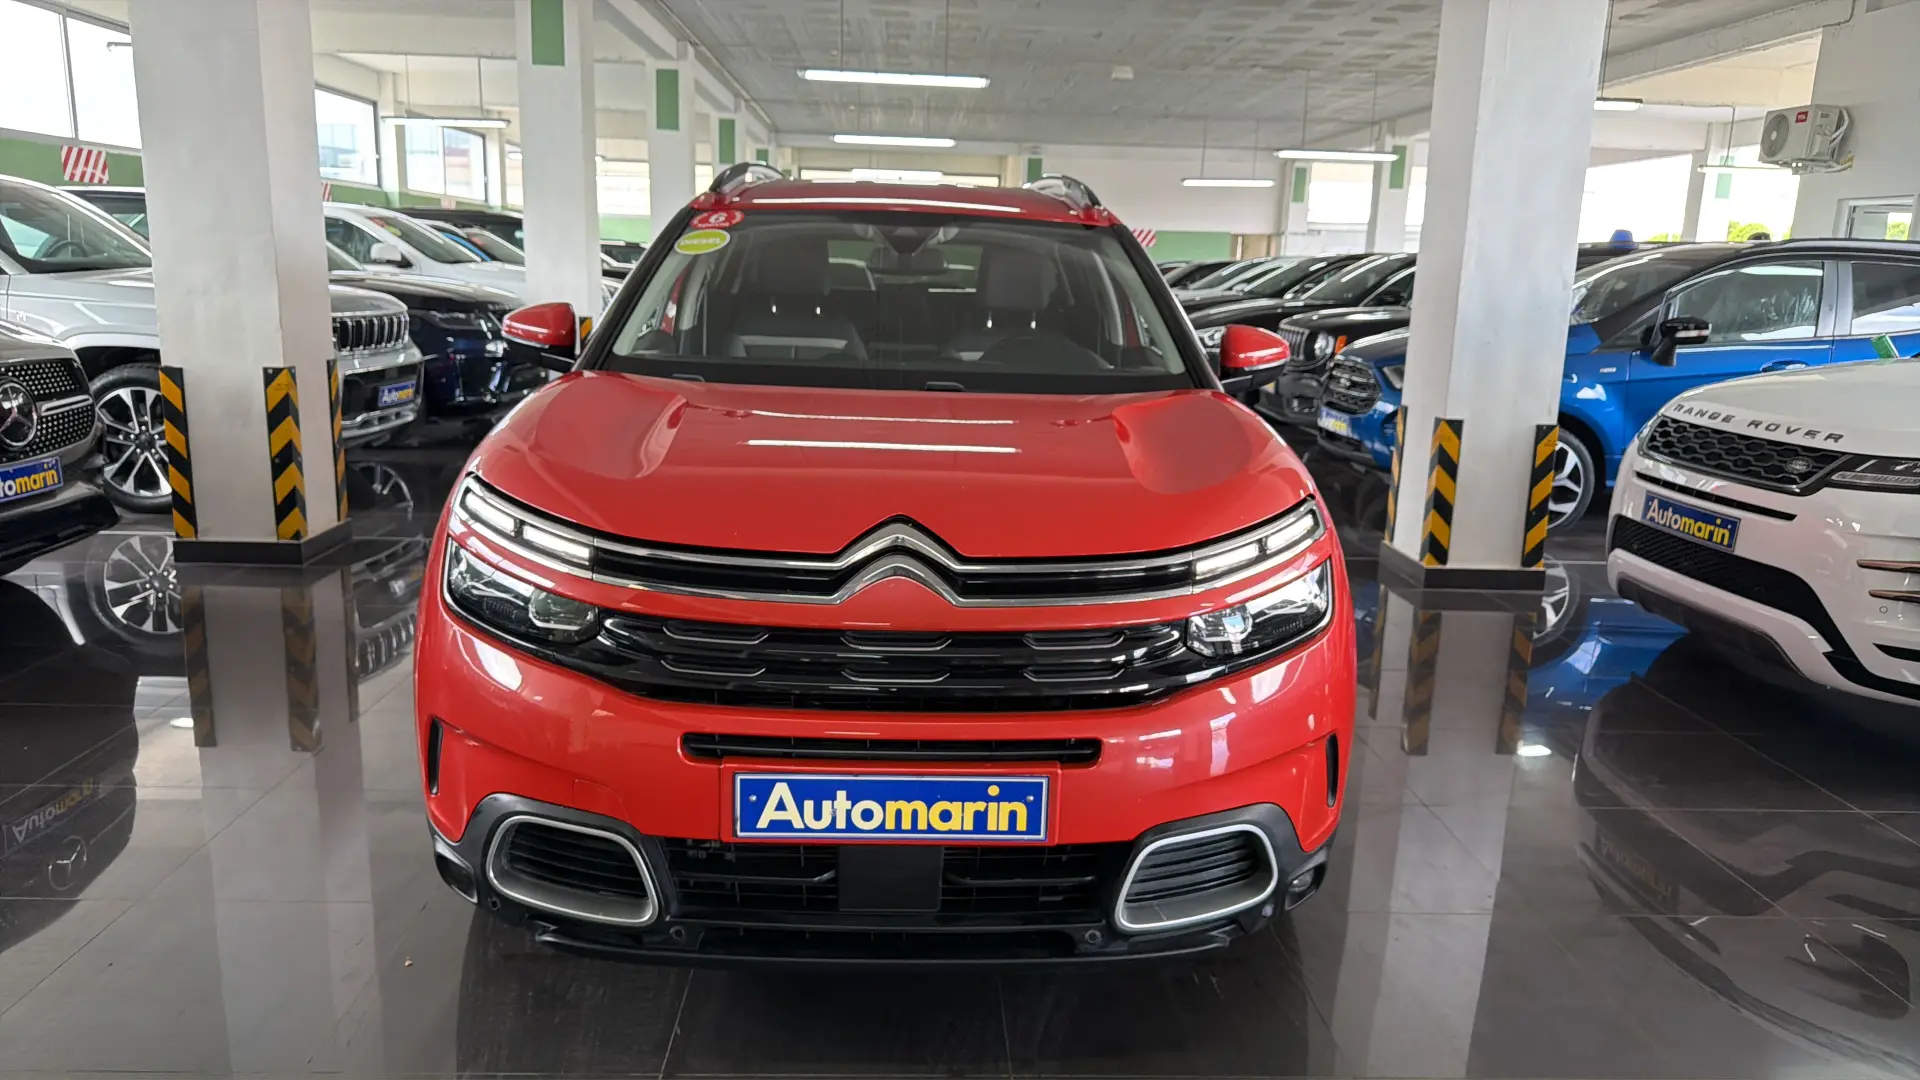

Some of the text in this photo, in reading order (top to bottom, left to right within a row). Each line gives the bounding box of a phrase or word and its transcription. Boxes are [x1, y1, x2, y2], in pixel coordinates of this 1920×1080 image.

[1673, 403, 1845, 444] RANGE ROVER
[1647, 498, 1731, 546] Automarin
[755, 781, 1028, 832] Automarin
